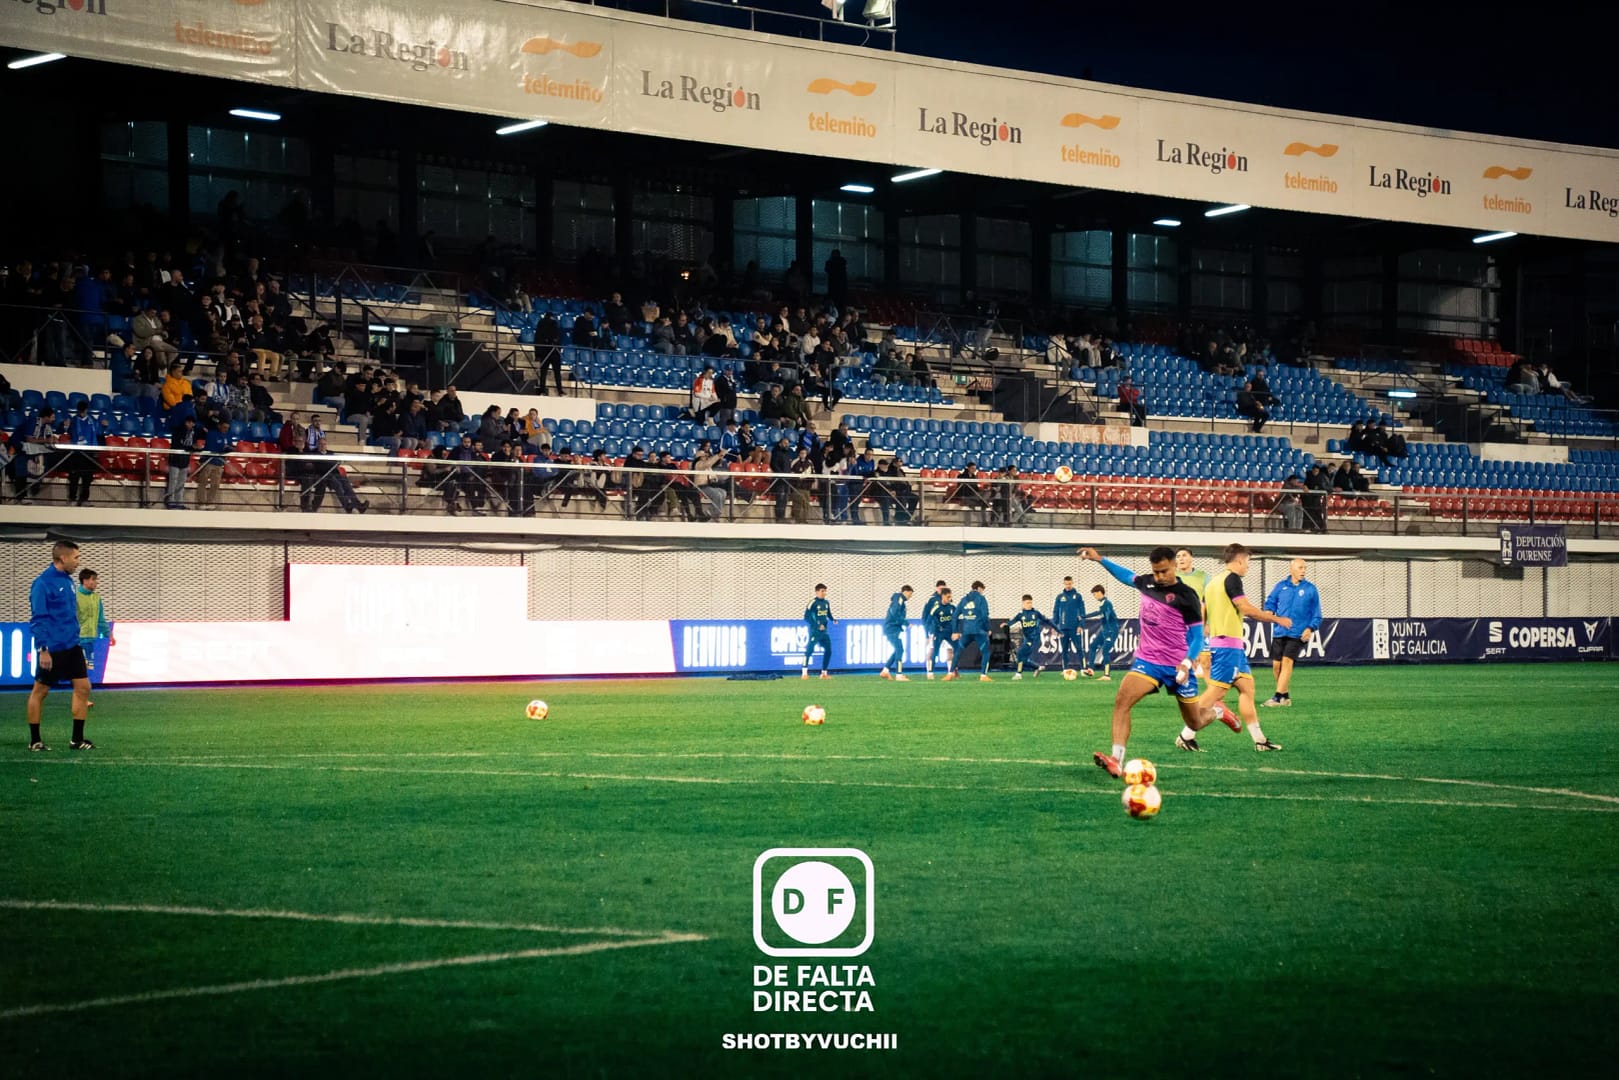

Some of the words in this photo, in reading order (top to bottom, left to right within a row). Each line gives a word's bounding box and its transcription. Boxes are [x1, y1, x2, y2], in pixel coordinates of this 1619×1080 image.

[325, 22, 366, 54] La
[524, 72, 603, 103] telemiño
[641, 69, 674, 100] La
[679, 75, 761, 113] Región
[808, 111, 877, 138] telemiño
[918, 107, 947, 135] La
[951, 111, 1022, 146] Región
[1060, 144, 1121, 168] telemiño
[1156, 139, 1182, 164] La
[1186, 142, 1249, 175] Región
[1284, 171, 1338, 194] telemiño
[1368, 165, 1392, 188] La
[1395, 168, 1452, 198] Región
[1483, 193, 1532, 214] telemiño
[1565, 187, 1586, 209] La
[1515, 533, 1565, 548] DEPUTACIÓN
[1516, 550, 1553, 561] OURENSE
[1391, 621, 1428, 637] XUNTA
[1508, 626, 1577, 648] COPERSA
[1391, 640, 1406, 655] DE
[1407, 639, 1448, 655] GALICIA
